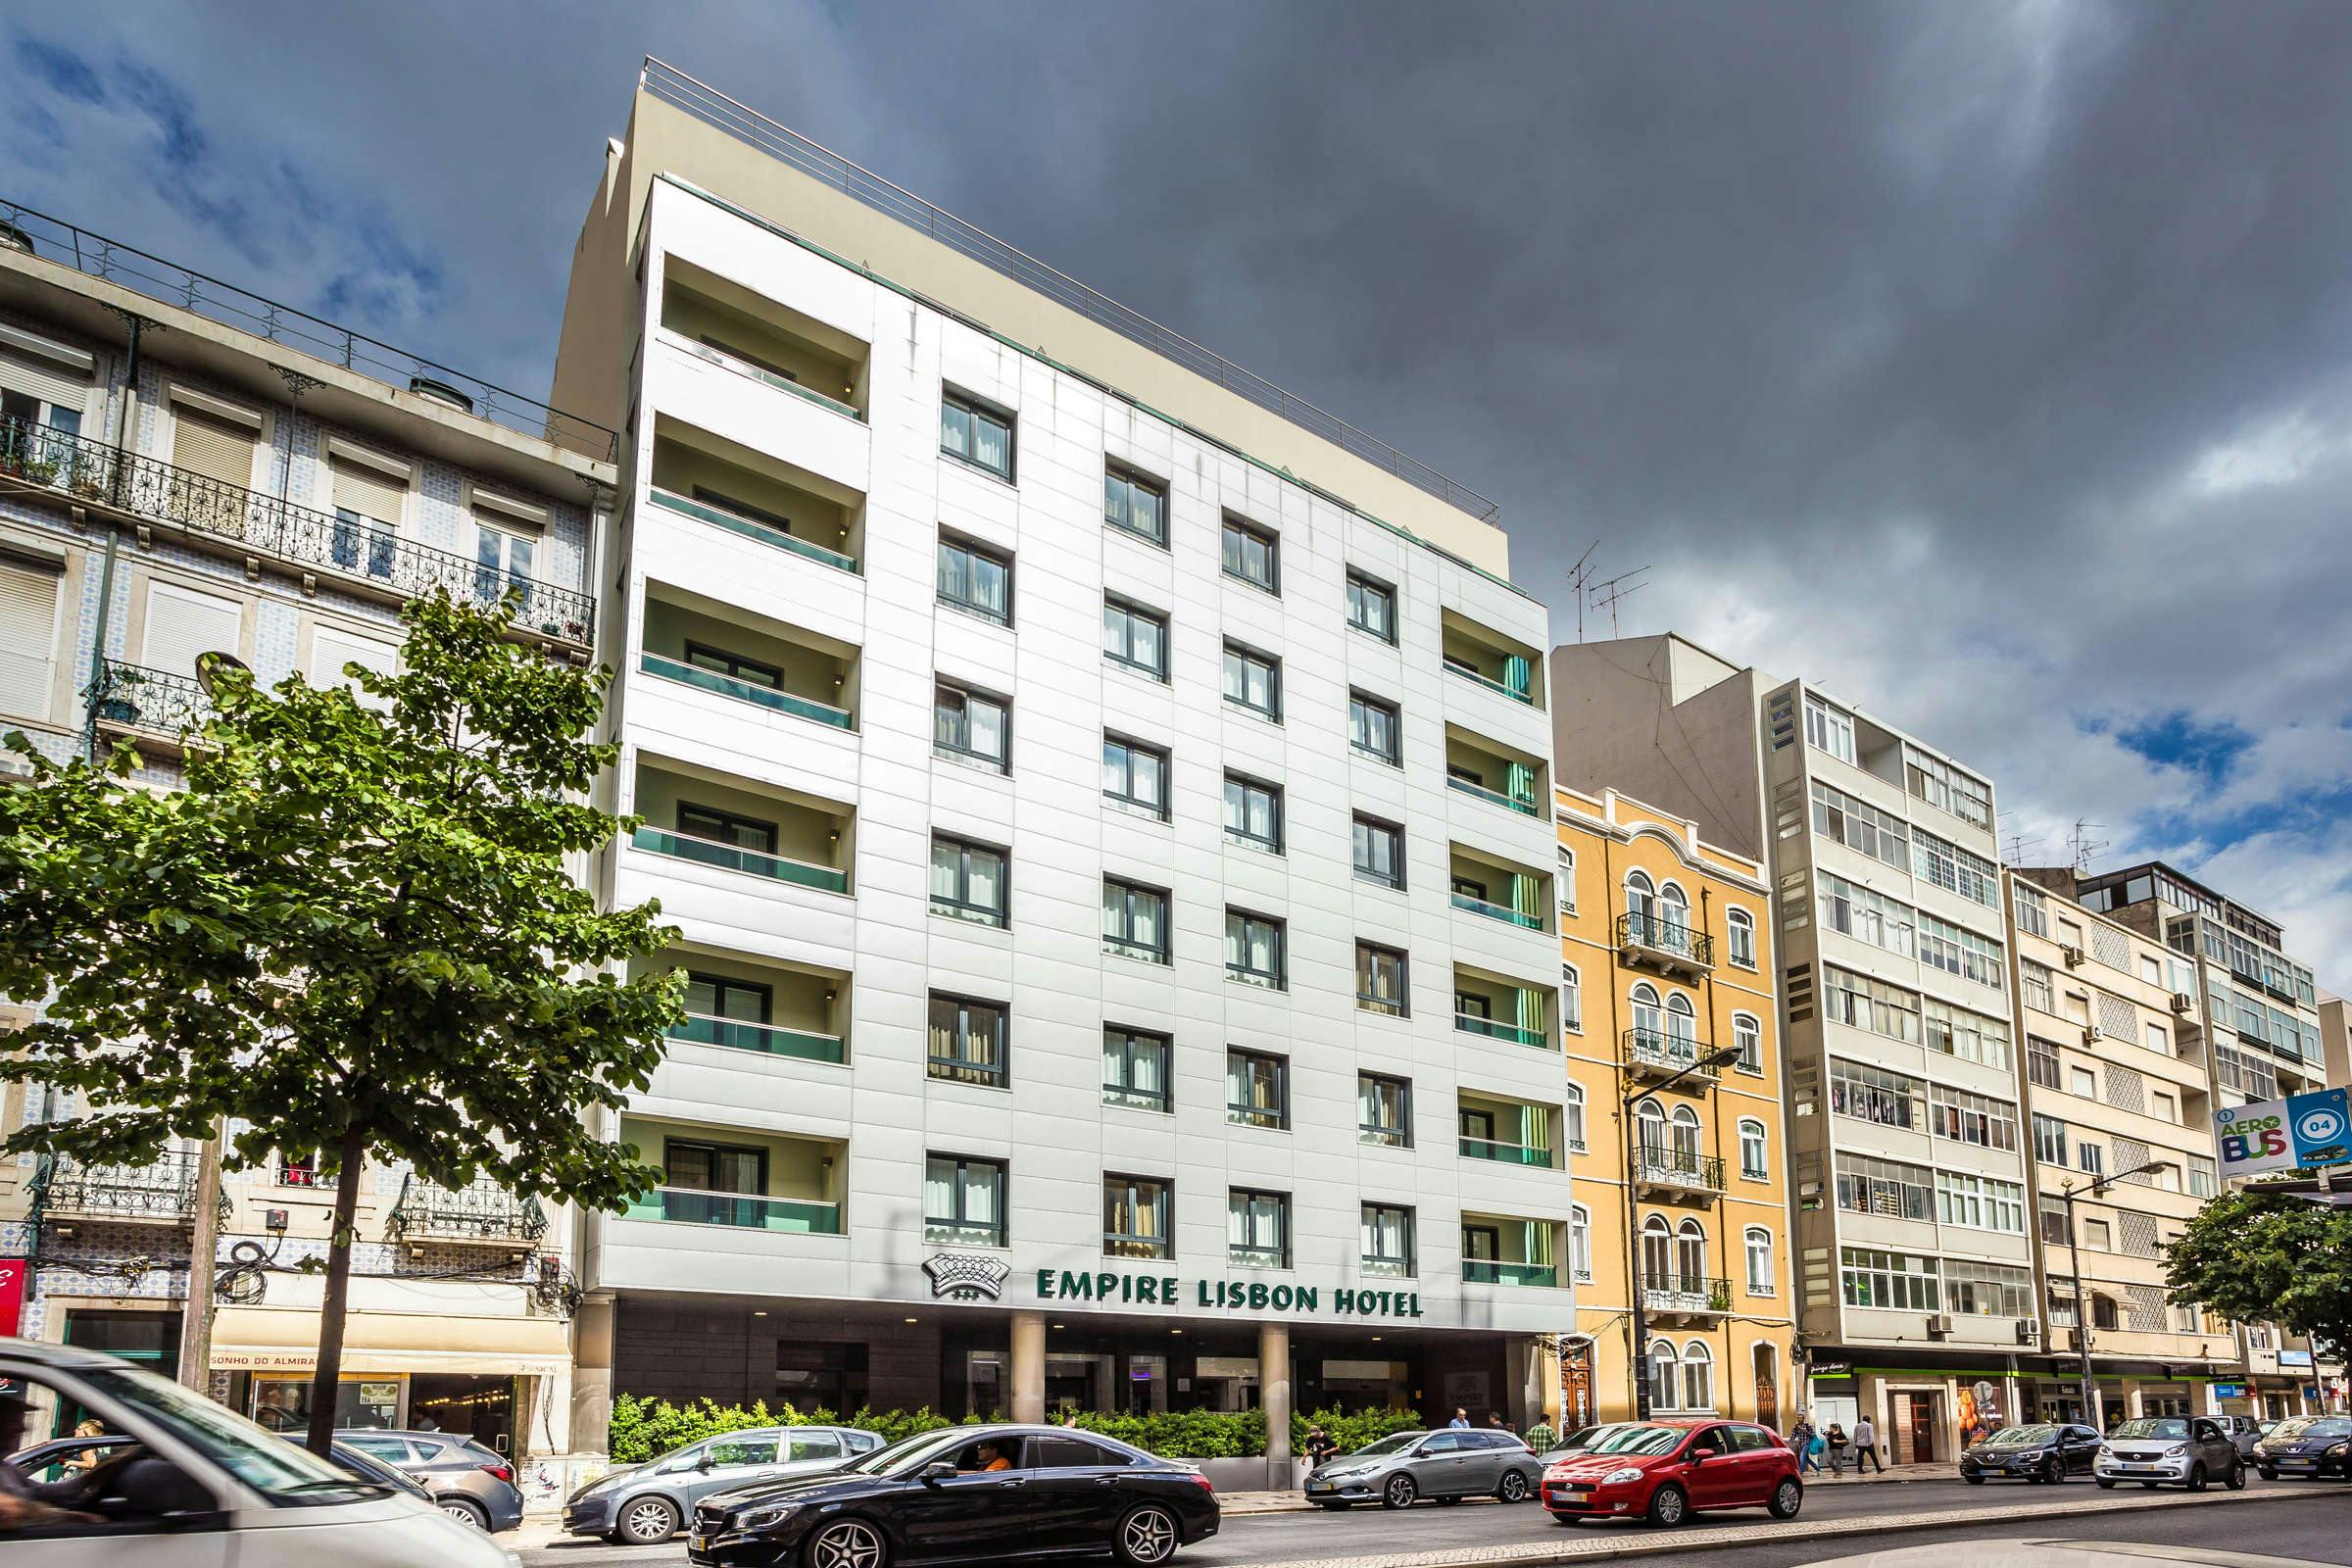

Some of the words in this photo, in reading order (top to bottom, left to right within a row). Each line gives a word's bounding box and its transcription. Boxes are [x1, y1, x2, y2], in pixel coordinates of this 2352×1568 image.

[2221, 1115, 2280, 1137] AERO
[2309, 1119, 2331, 1133] 04
[2221, 1128, 2287, 1163] BUS
[1037, 1268, 1179, 1305] EMPIRE
[1198, 1279, 1318, 1312] LISBON
[1335, 1288, 1424, 1317] HOTEL
[210, 1356, 249, 1365] SONHO
[253, 1356, 269, 1365] DO
[273, 1356, 317, 1366] ALMIRA
